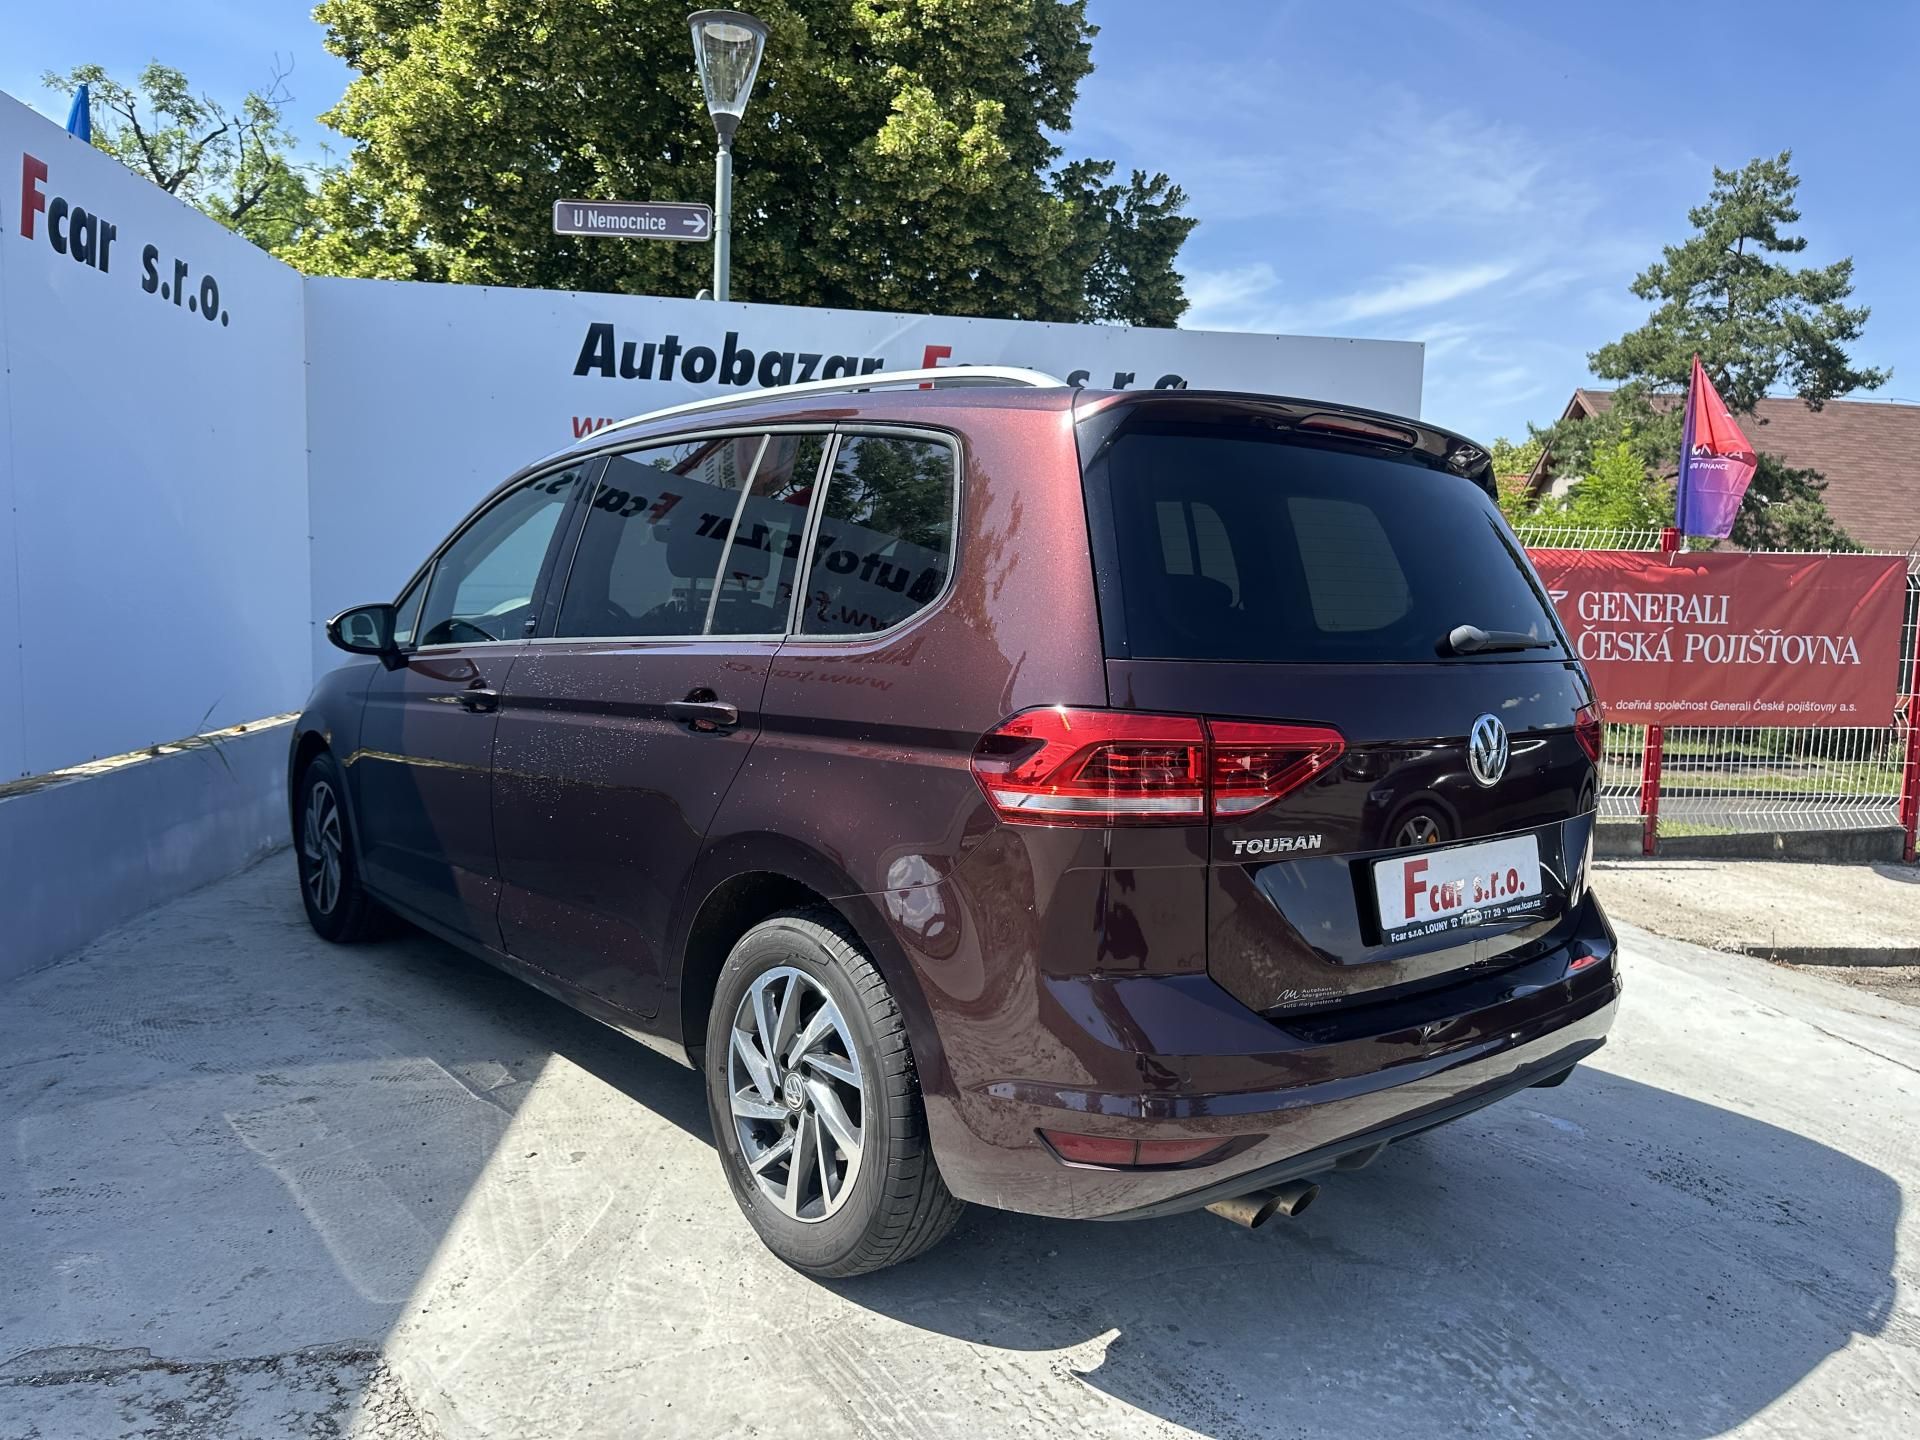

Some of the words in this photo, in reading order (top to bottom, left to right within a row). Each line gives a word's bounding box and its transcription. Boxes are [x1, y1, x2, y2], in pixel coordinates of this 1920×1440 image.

[574, 209, 583, 227] U
[588, 210, 667, 231] Nemocnice
[20, 152, 117, 273] Fcar
[141, 244, 229, 328] s.r.o.
[1577, 591, 1730, 625] GENERALI
[1577, 624, 1674, 661] ČESKÁ
[1682, 628, 1861, 664] POJIŠŤOVNA
[1616, 700, 1651, 710] dceřiná
[1654, 700, 1707, 712] společnost
[1710, 701, 1751, 711] Generali
[1753, 699, 1784, 711] České
[1787, 701, 1837, 713] pojišťovny
[1840, 702, 1857, 712] a.s.
[1232, 834, 1322, 855] TOURAN
[1404, 858, 1465, 919] Fcar
[1473, 868, 1525, 903] s.r.o.
[1391, 930, 1406, 943] Fcar
[1408, 927, 1424, 939] s.r.o.
[1425, 920, 1448, 933] LOUNY
